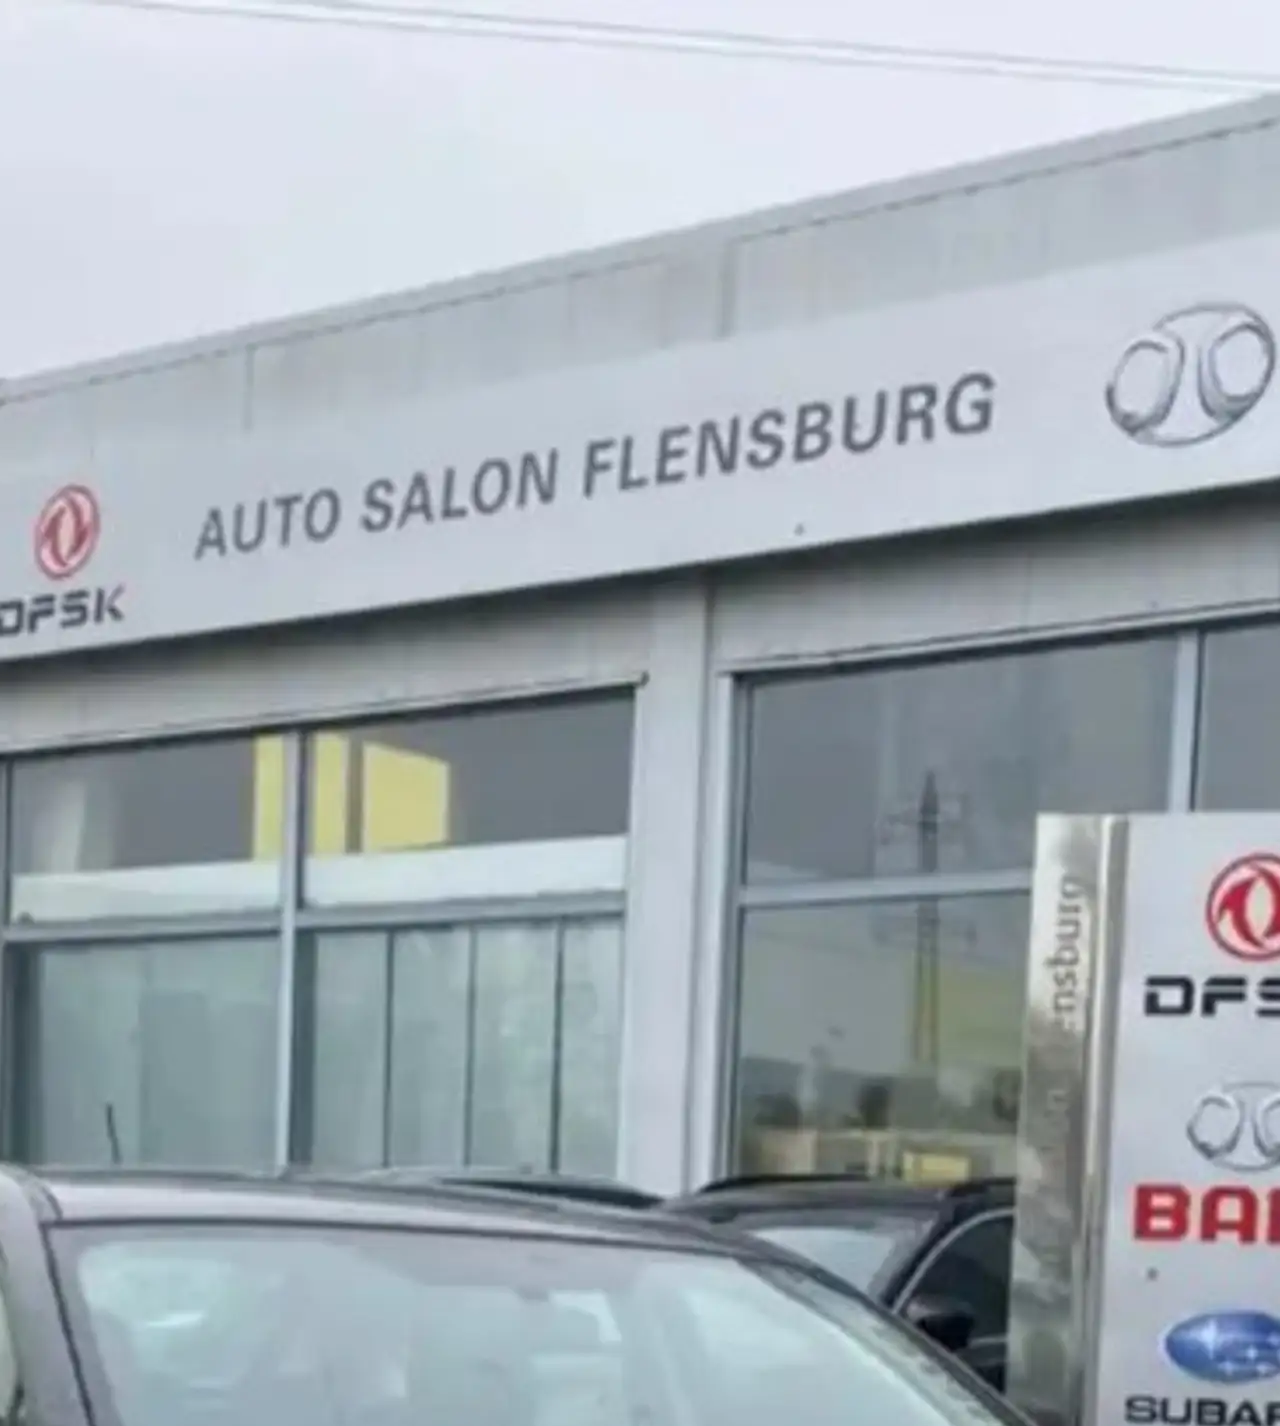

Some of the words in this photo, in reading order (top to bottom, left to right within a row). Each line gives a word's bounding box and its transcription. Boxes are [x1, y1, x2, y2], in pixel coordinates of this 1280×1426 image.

[194, 488, 341, 561] AUTO
[360, 450, 560, 534] SALON
[583, 372, 995, 499] FLENSBURG
